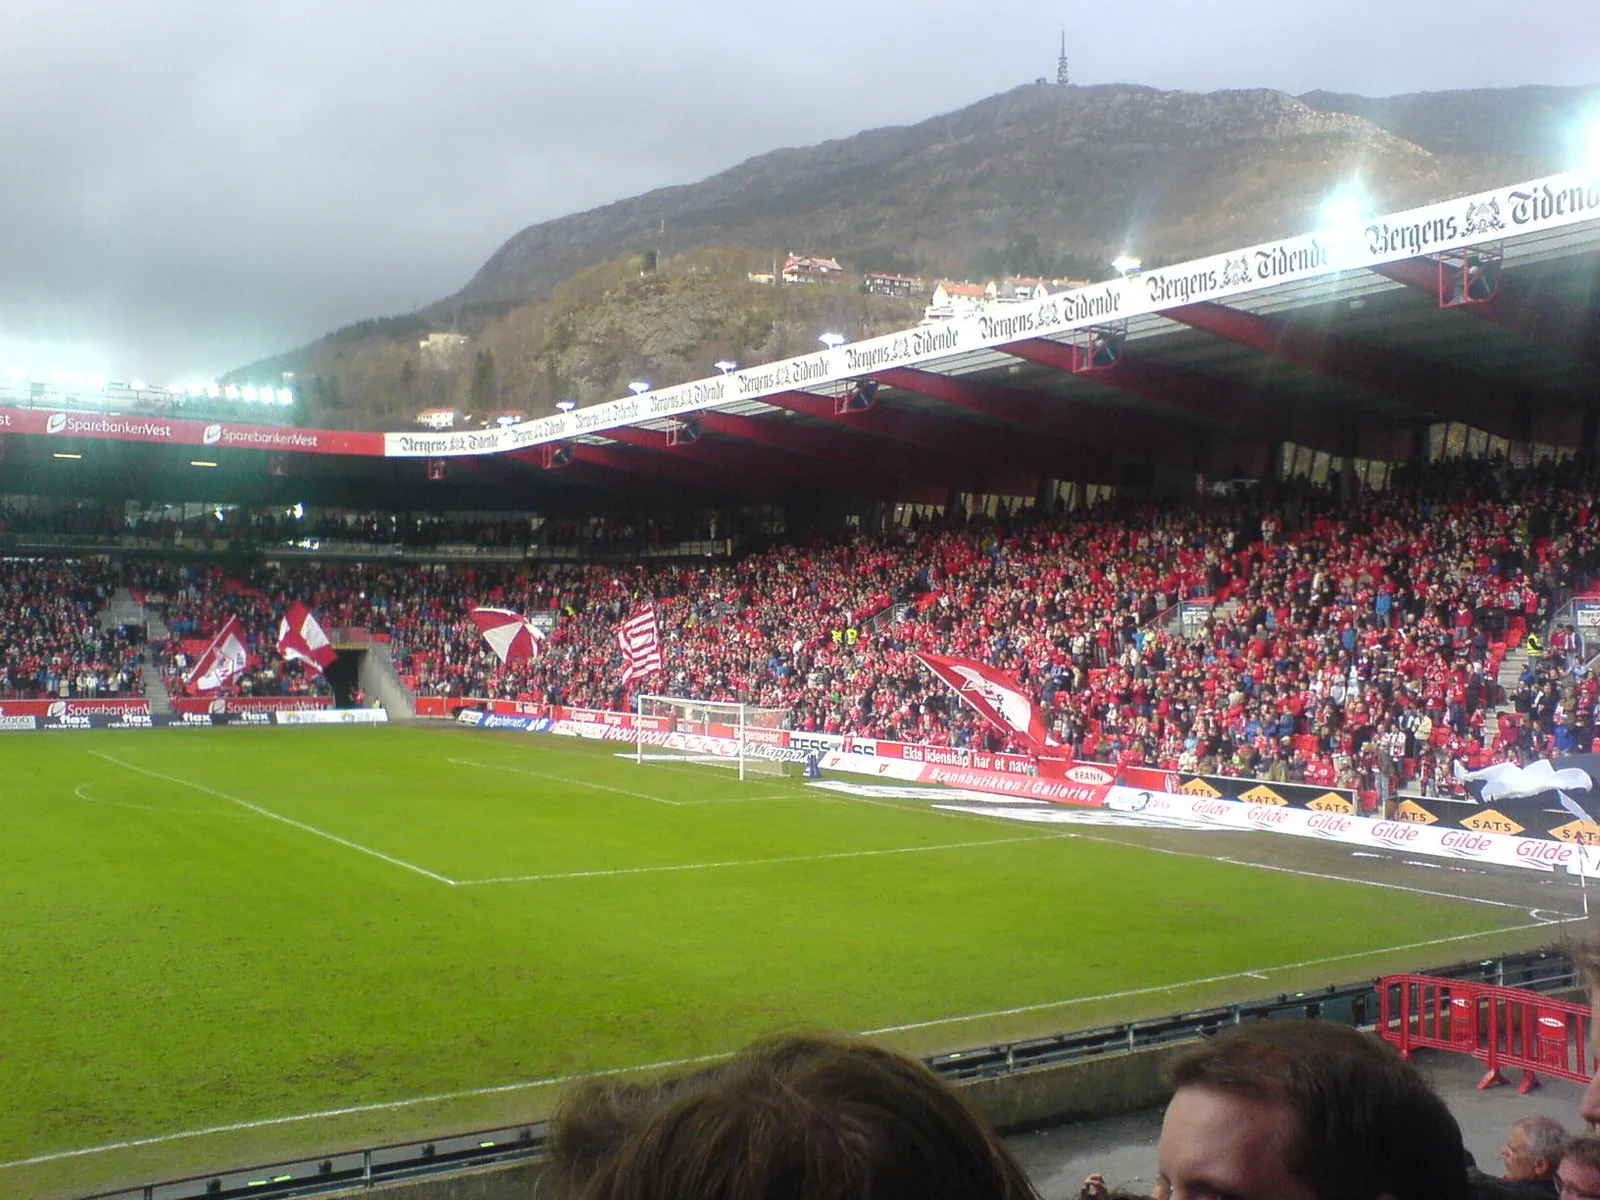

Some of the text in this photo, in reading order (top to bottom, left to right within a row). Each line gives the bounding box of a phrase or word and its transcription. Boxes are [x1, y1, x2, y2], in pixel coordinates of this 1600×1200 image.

[1364, 216, 1459, 255] Bergens
[1146, 268, 1218, 303] Bergens
[978, 287, 1121, 341] Bergens Tidende
[845, 325, 959, 371] Bergens Tidende
[737, 357, 830, 394] Bergens Tidende
[693, 382, 725, 405] Tidende
[67, 418, 171, 437] SparebankenVest
[222, 430, 318, 447] SparebankenVest
[399, 435, 500, 455] Bergens Tidende
[59, 714, 91, 724] flex
[122, 713, 152, 723] flex
[182, 712, 212, 722] flex
[790, 737, 831, 751] TESS
[902, 745, 923, 762] Ekte
[925, 748, 970, 769] lidenskap
[974, 753, 990, 769] har
[994, 758, 1005, 771] et
[1074, 768, 1104, 781] BRANN
[929, 768, 1020, 792] Brannbutikken
[1032, 780, 1096, 801] Galleriet
[1184, 786, 1213, 798] SATS
[1192, 800, 1231, 816] Gilde
[1247, 794, 1278, 805] SATS
[1316, 802, 1349, 813] SATS
[1247, 806, 1289, 824] Gilde
[1307, 814, 1352, 832] Gilde
[1395, 811, 1427, 823] ATS
[1371, 821, 1419, 841] Gilde
[1472, 819, 1511, 832] SATS
[1441, 830, 1493, 851] Gilde
[1562, 829, 1600, 843] SAT
[1516, 839, 1573, 862] Gilde
